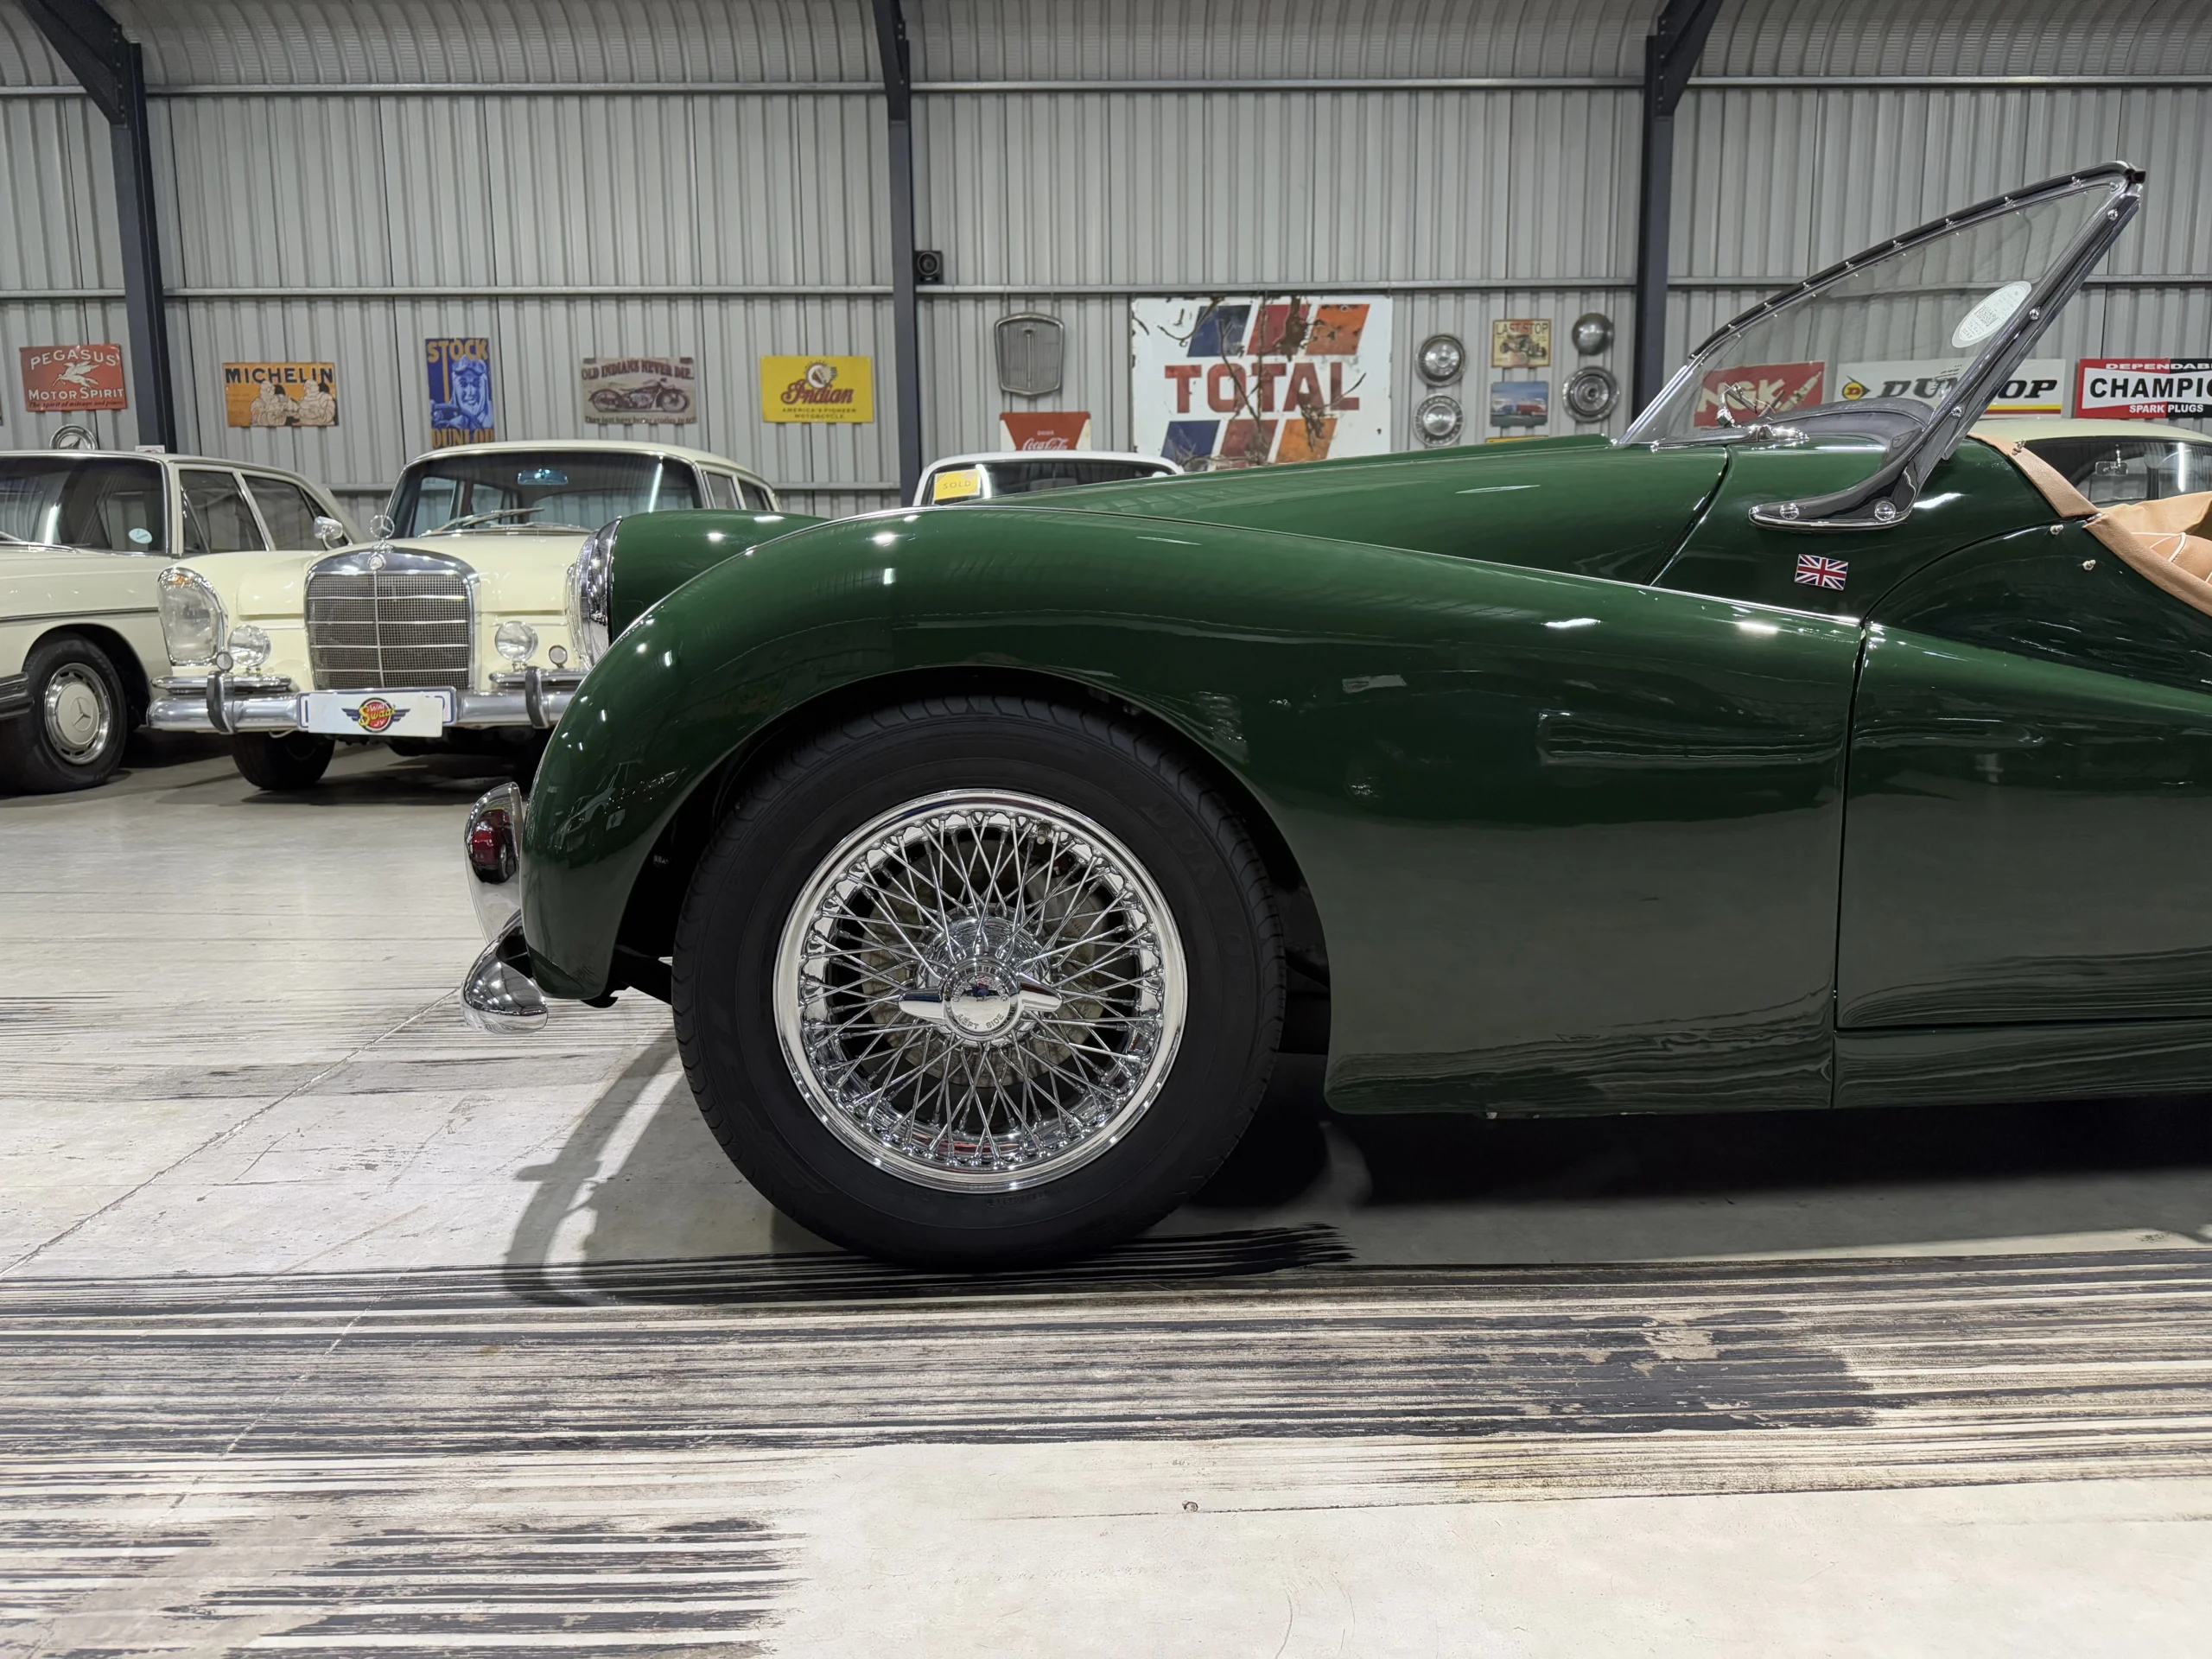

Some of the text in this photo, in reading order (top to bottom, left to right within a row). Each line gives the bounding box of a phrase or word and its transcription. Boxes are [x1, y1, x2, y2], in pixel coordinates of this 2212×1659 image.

[1496, 321, 1549, 335] LAST STOP
[30, 349, 117, 370] PEGASUS
[225, 367, 334, 384] MICHELIN
[582, 366, 600, 380] OLD
[601, 359, 639, 378] INDIANS
[640, 359, 673, 377] NEVER
[28, 387, 124, 400] MOTOR SPIRIT
[780, 378, 855, 405] Indian
[1164, 362, 1360, 413] TOTAL
[1696, 378, 1785, 413] NGK
[1876, 378, 2058, 399] DUOP
[2129, 404, 2204, 413] SPARK PLUGS
[943, 480, 971, 490] SOLD
[956, 1013, 1005, 1029] LEFT SIDE
